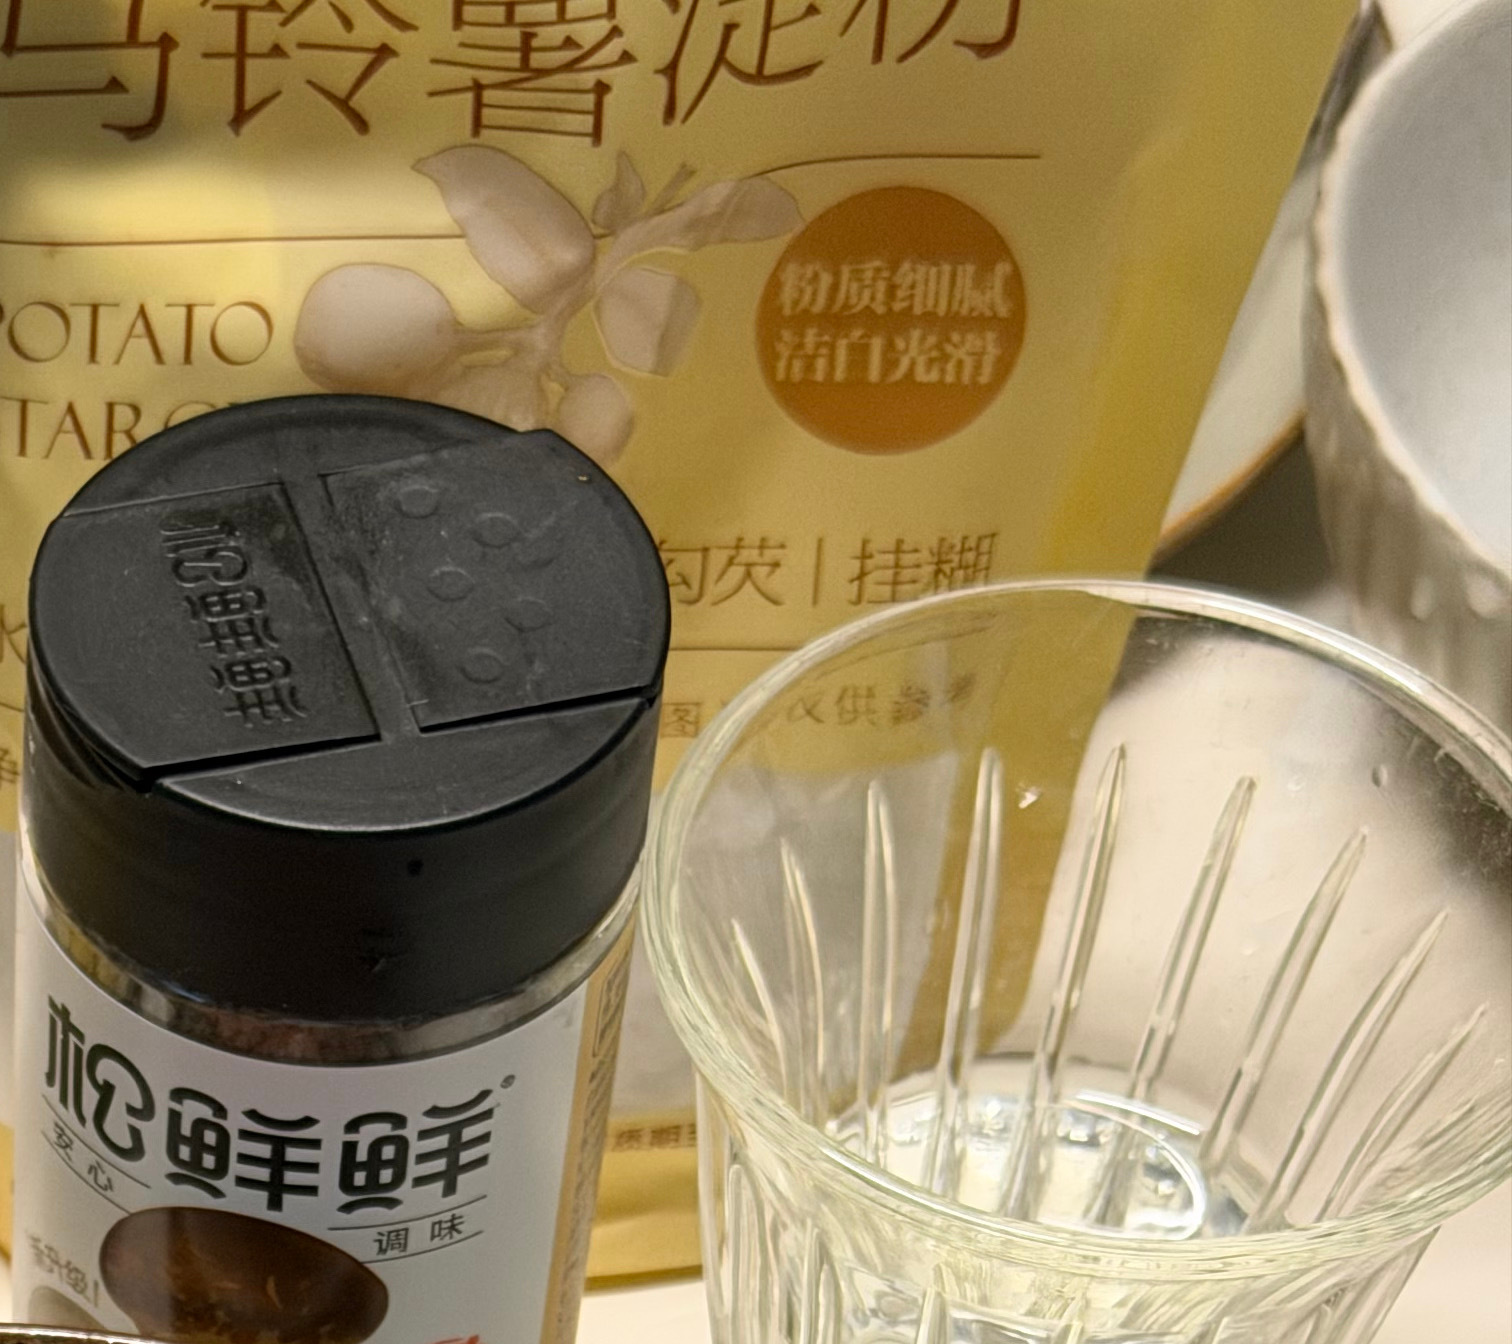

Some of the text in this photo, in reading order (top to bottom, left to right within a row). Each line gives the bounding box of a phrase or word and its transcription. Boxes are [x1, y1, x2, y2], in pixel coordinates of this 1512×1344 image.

[779, 259, 1013, 318] 粉质细腻
[775, 328, 1000, 383] 洁白光滑
[658, 533, 787, 607] 勾芡
[846, 531, 999, 606] 挂糊
[45, 995, 497, 1215] 松鲜鲜
[372, 1211, 466, 1257] 调味
